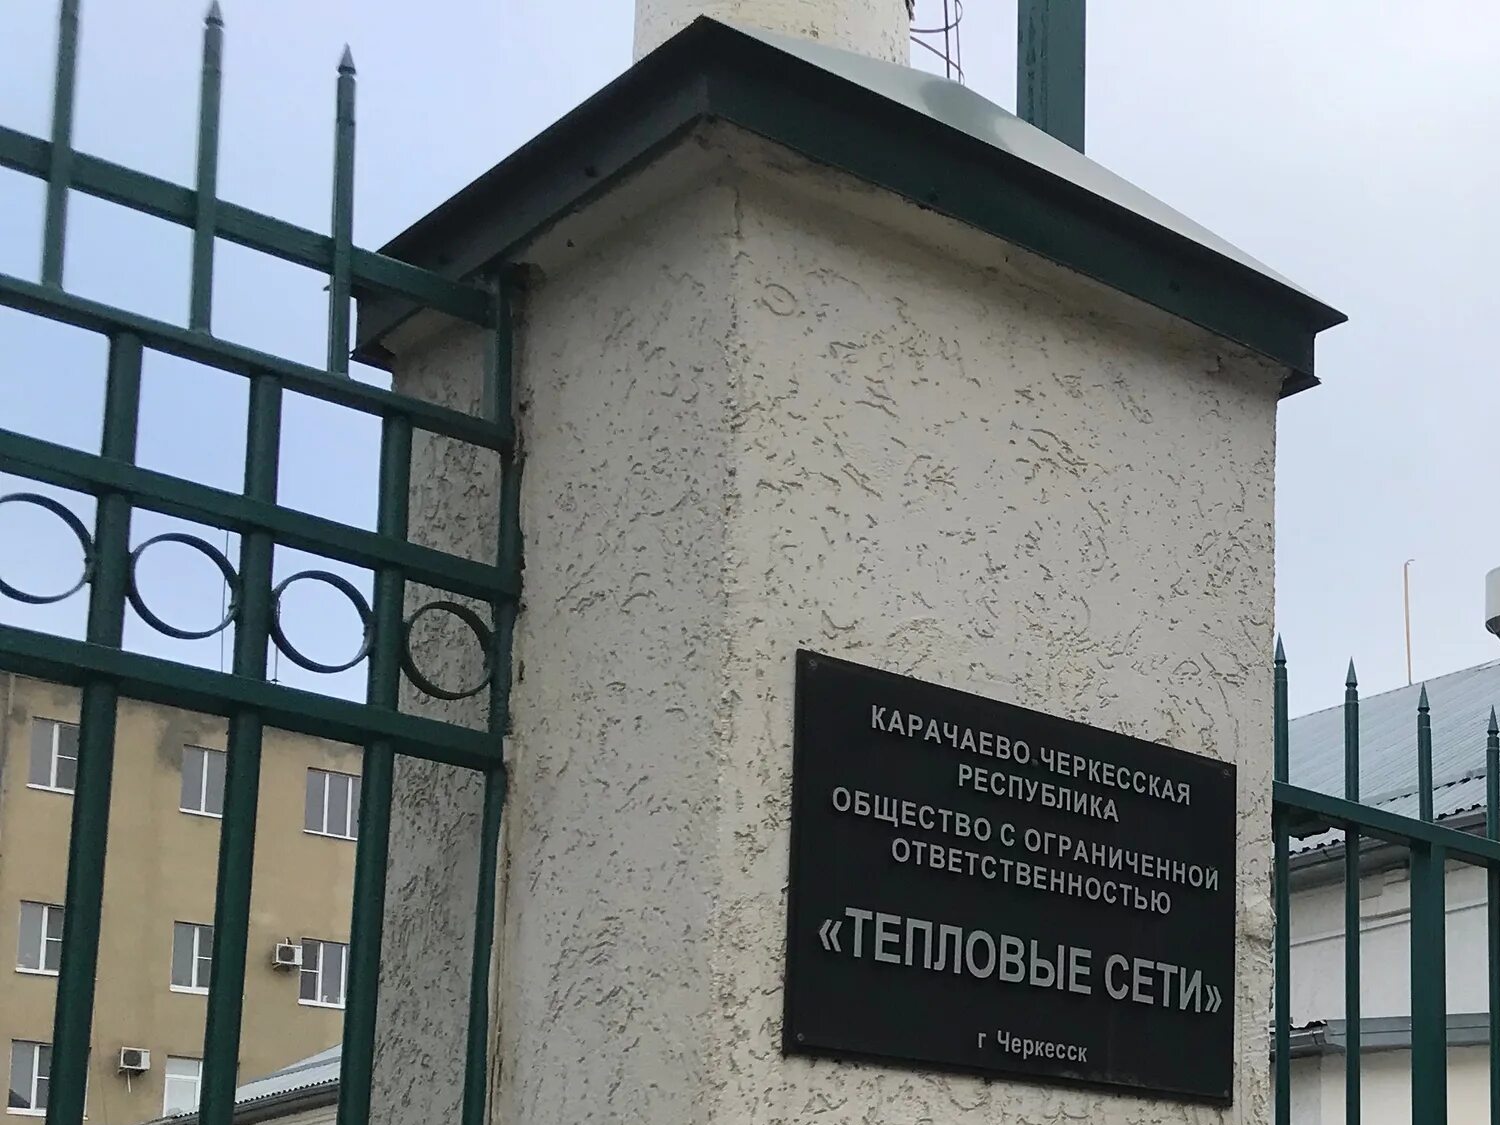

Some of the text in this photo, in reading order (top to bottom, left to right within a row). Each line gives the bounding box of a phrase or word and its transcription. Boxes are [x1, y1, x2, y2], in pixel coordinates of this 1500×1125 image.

[958, 764, 1120, 823] РЕСПУБЛИКА
[832, 786, 1219, 891] ОБЩЕСТВО С ОГРАНИЧЕННОЙ
[892, 838, 1171, 915] ОТВЕТСТВЕННОСТЬЮ
[818, 907, 1222, 1013] «ТЕПЛОВЫЕ СЕТИ»
[978, 1030, 1088, 1063] г Черкесск
